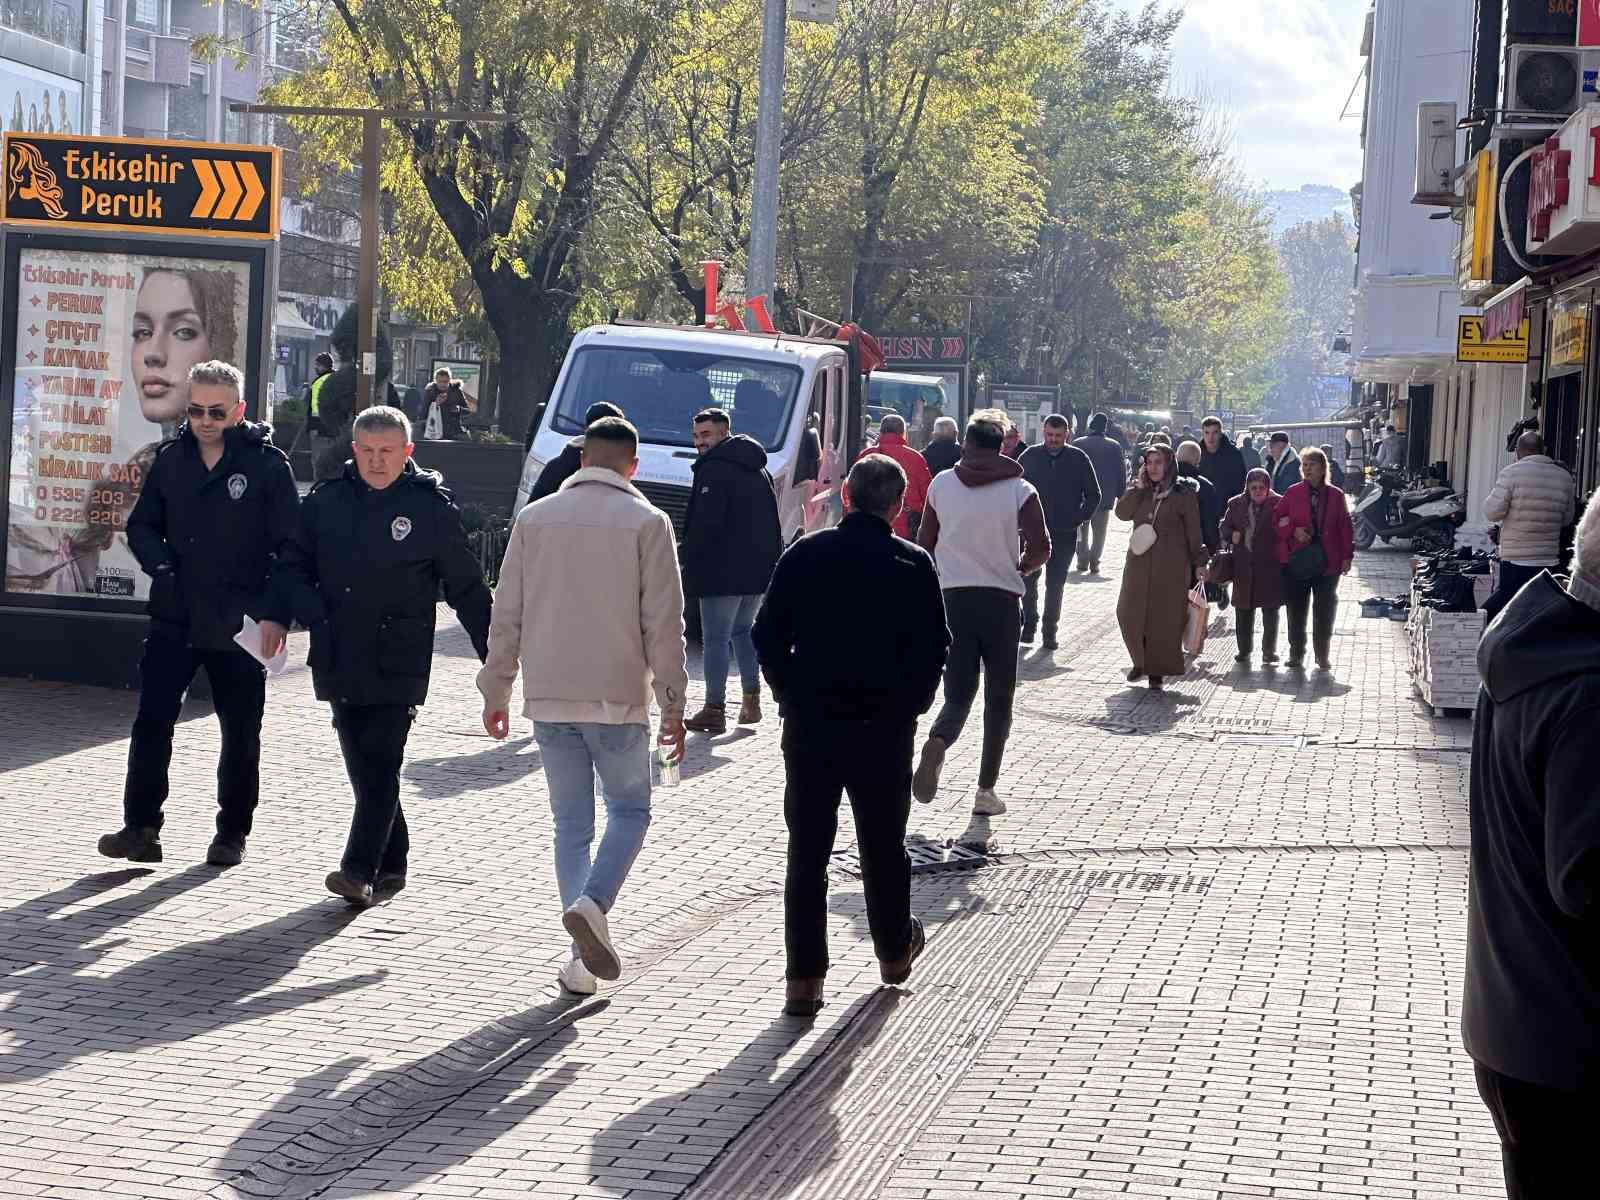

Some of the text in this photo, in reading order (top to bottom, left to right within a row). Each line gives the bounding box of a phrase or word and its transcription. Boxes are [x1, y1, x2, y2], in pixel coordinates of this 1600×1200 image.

[62, 149, 185, 184] Eskisehir
[81, 185, 163, 218] Peruk
[91, 268, 136, 289] Peruk
[46, 291, 105, 314] PERUK
[43, 347, 110, 370] KAYNAK
[41, 374, 123, 400] YARIM AY
[109, 462, 142, 488] SAÇ
[36, 485, 48, 501] 0
[90, 489, 125, 505] 203
[89, 511, 122, 528] 220
